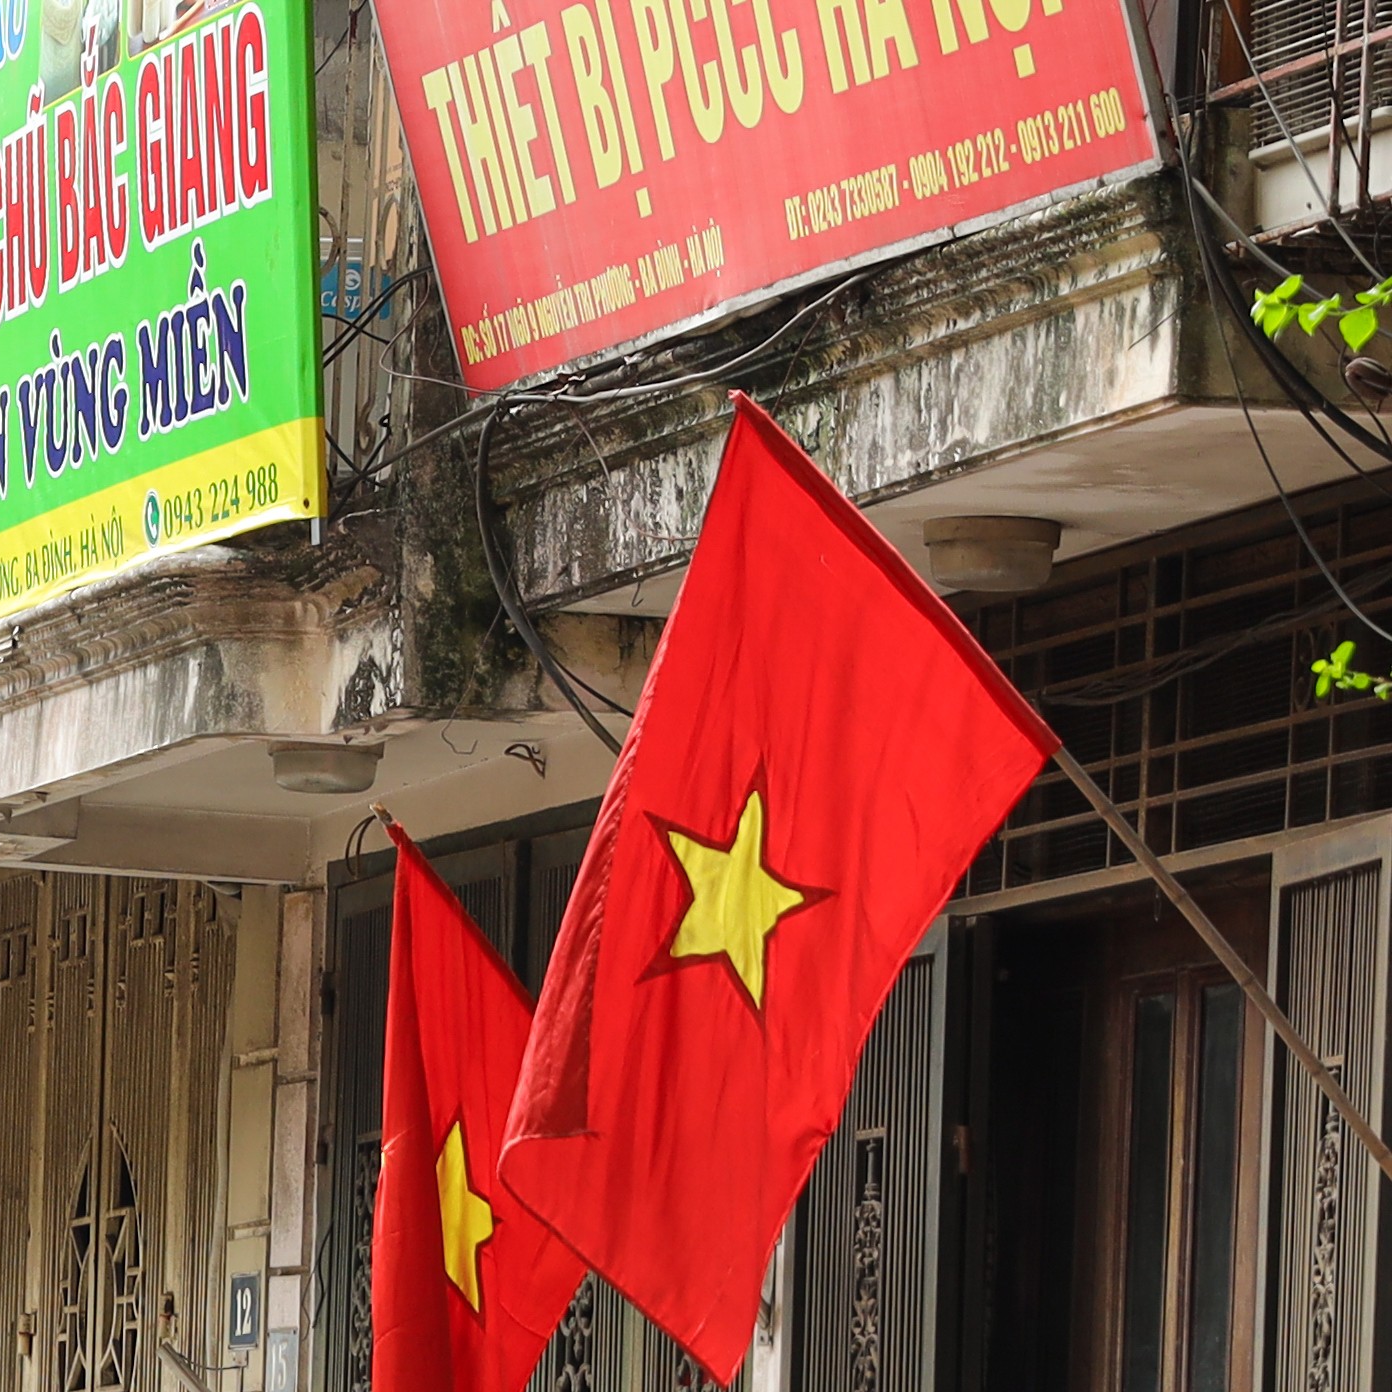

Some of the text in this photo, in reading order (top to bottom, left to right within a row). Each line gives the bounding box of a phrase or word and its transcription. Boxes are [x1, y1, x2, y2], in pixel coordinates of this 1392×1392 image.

[56, 14, 129, 293] BẮC
[137, 2, 272, 251] GIANG
[560, 0, 652, 218] BỊ
[631, 0, 804, 162] PCCC
[807, 183, 842, 234] 0243
[841, 164, 900, 223] 7330587
[908, 150, 948, 199] 0904
[947, 138, 979, 188] 192
[977, 128, 1009, 178] 212
[1017, 110, 1060, 164] 0913
[1058, 99, 1091, 151] 211
[1090, 87, 1125, 138] 600
[574, 282, 597, 324] TRI
[637, 254, 659, 298] BA
[653, 239, 684, 292] ĐÌNH
[686, 225, 707, 278] HÀ
[702, 217, 725, 278] NỘI
[17, 329, 130, 489] VÙNG
[137, 236, 250, 442] MIỀN
[25, 551, 39, 590] BA
[80, 512, 98, 569] HÀ
[163, 462, 279, 539] 0943 224 988
[235, 1287, 252, 1337] 12
[270, 1341, 288, 1392] 15
